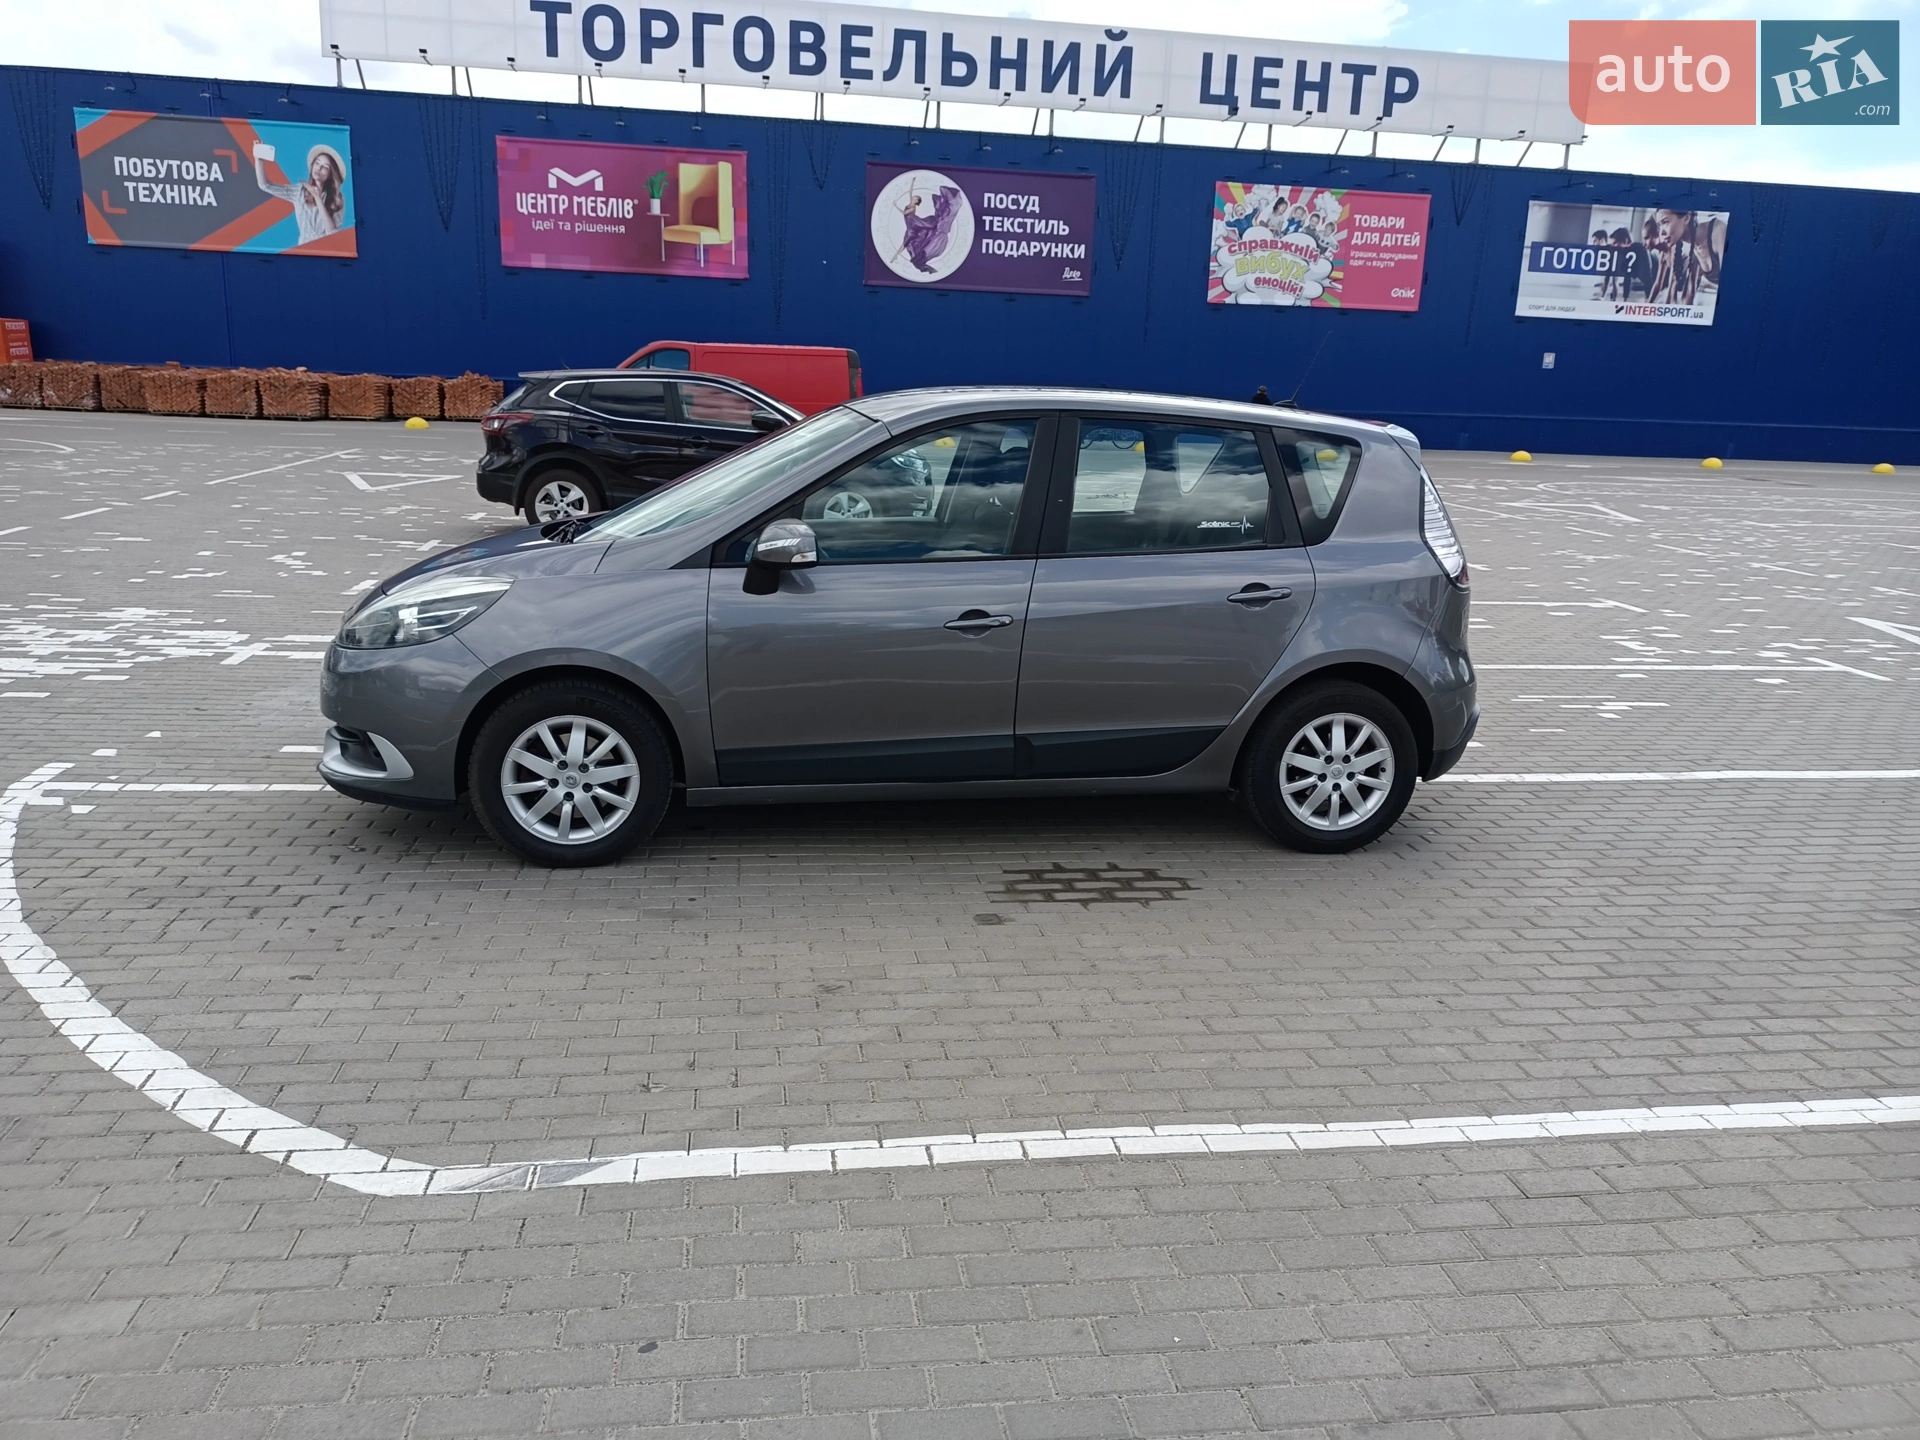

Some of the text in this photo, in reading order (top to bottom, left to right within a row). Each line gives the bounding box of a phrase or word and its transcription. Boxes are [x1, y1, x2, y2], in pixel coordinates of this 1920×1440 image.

[529, 0, 1420, 118] ТОРГОВЕЛЬНИЙ ЦЕНТР
[113, 156, 224, 182] ПОБУТОВА
[123, 181, 218, 207] ТЕХНІКА
[516, 192, 569, 215] ЦЕНТР
[983, 192, 1040, 214] ПОСУД
[532, 218, 626, 234] ідеї та рішення
[982, 215, 1070, 235] ТЕКСТИЛЬ
[1353, 214, 1405, 229] ТОВАРИ
[981, 238, 1086, 259] ПОДАРУНКИ
[1351, 231, 1420, 247] ДЛЯ ДІТЕЙ
[1227, 238, 1320, 263] справжній
[1540, 246, 1637, 273] ГОТОВІ ?
[1235, 252, 1308, 281] вибух
[1254, 276, 1304, 298] емоцій!
[1625, 304, 1704, 319] INTERSPORT.ua
